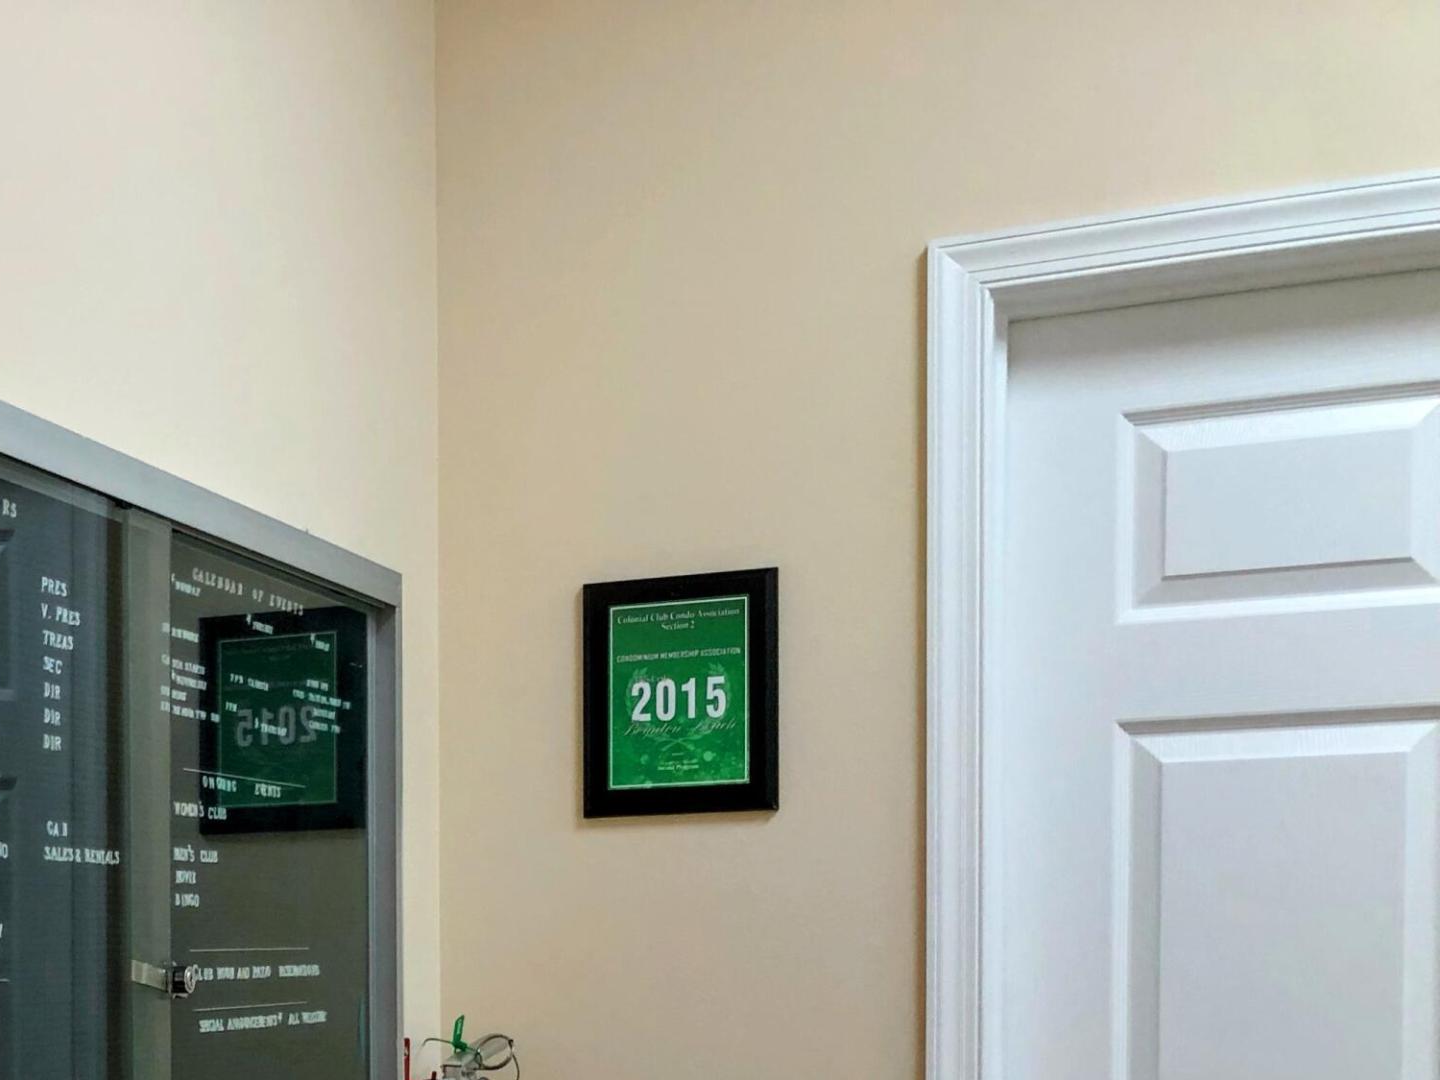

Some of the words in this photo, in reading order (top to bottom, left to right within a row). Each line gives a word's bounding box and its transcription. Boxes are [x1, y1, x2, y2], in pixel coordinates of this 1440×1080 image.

[41, 576, 68, 598] PRES
[192, 567, 243, 596] CALENDAR
[252, 588, 264, 602] OF
[56, 606, 81, 626] PRES
[617, 613, 649, 626] Colonial
[650, 612, 669, 623] Club
[670, 610, 695, 621] Condo
[697, 607, 740, 618] Association
[661, 621, 689, 631] Section
[690, 620, 696, 629] 2
[42, 629, 75, 651] TREAS
[660, 650, 700, 660] MEMBERSHIP
[700, 647, 742, 657] ASSOCIATION
[42, 655, 64, 676] SEC
[43, 682, 61, 700] DIR
[631, 675, 727, 723] 2015
[43, 708, 61, 727] DIR
[43, 734, 62, 752] DIR
[208, 806, 228, 821] CLUB
[44, 845, 74, 862] SALES
[85, 848, 120, 865] RENTALS
[200, 850, 219, 864] CLUB
